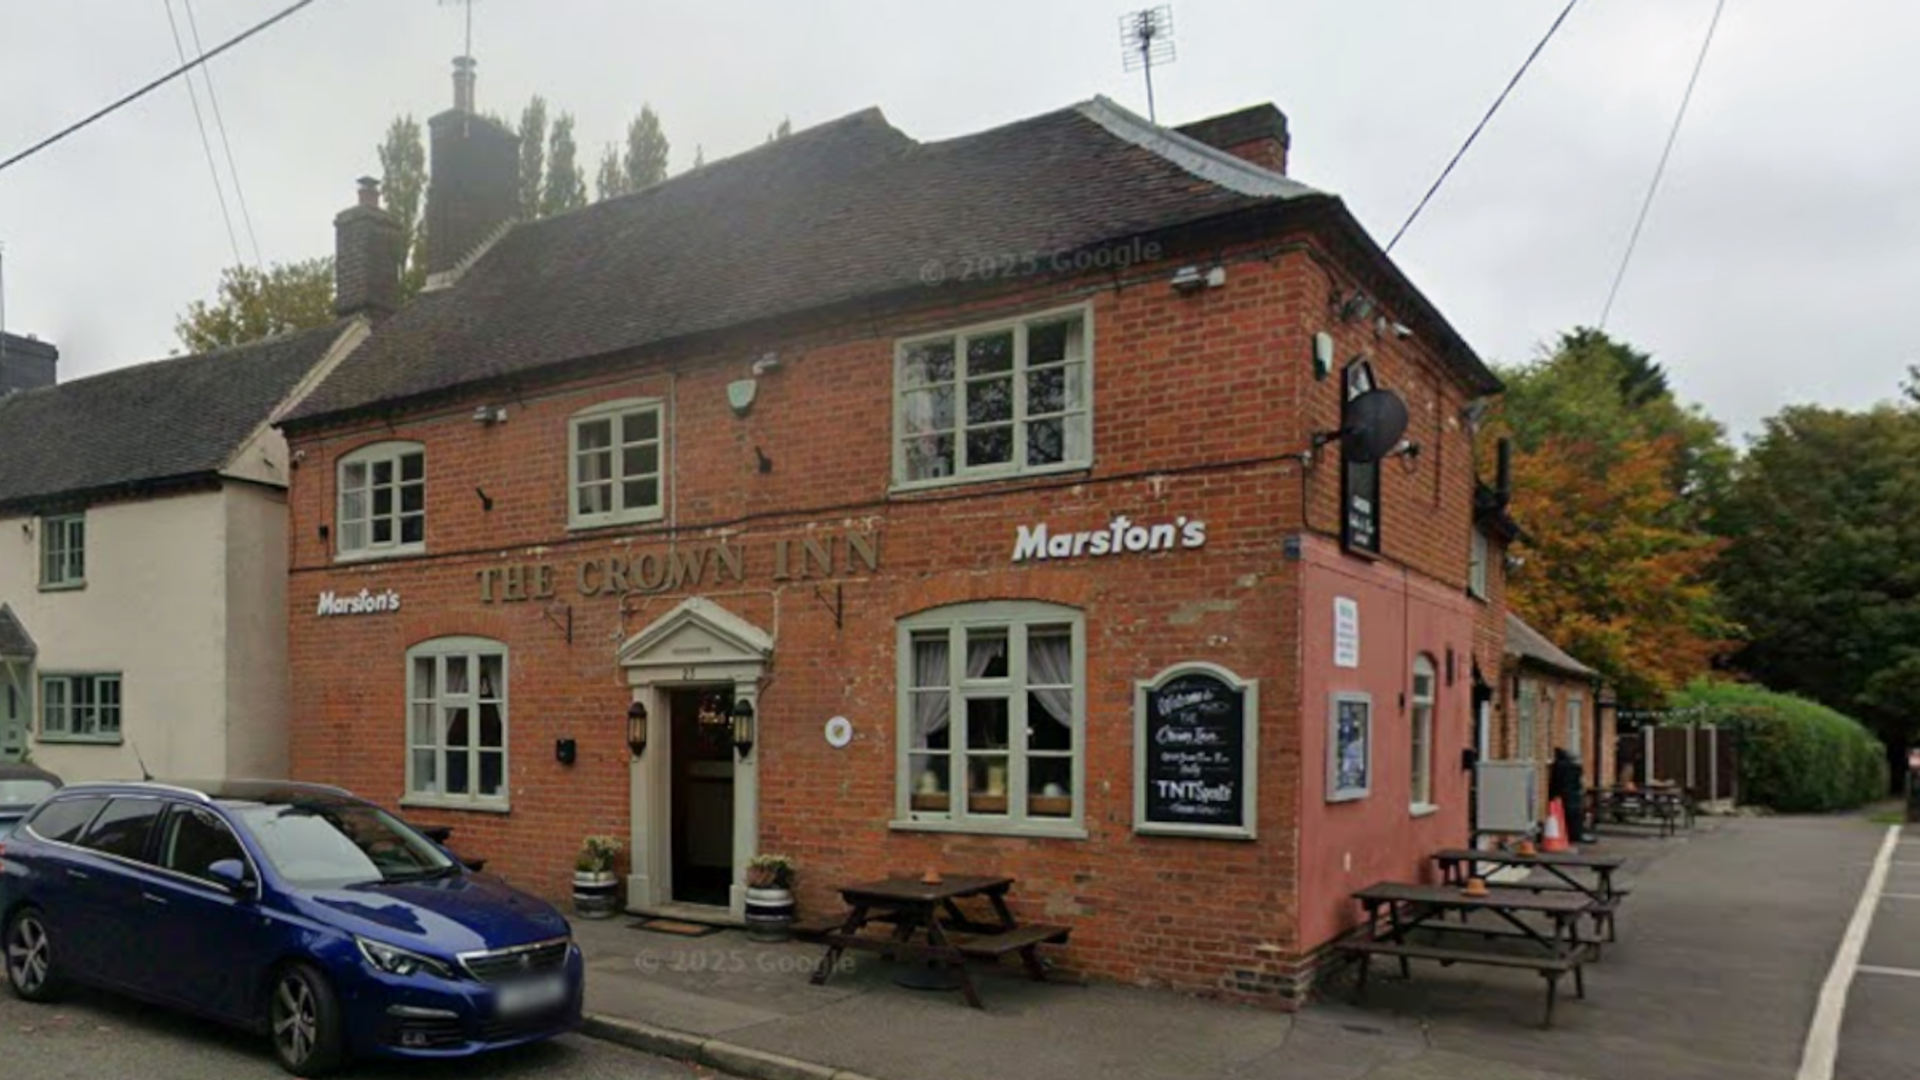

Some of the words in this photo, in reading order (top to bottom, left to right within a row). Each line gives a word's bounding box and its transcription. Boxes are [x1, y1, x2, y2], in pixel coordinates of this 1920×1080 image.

[1011, 515, 1206, 562] Marston's
[475, 564, 554, 603] THE
[576, 541, 747, 597] CROWN
[772, 530, 882, 582] INN
[317, 588, 400, 617] Marston's
[1157, 780, 1197, 799] TNT
